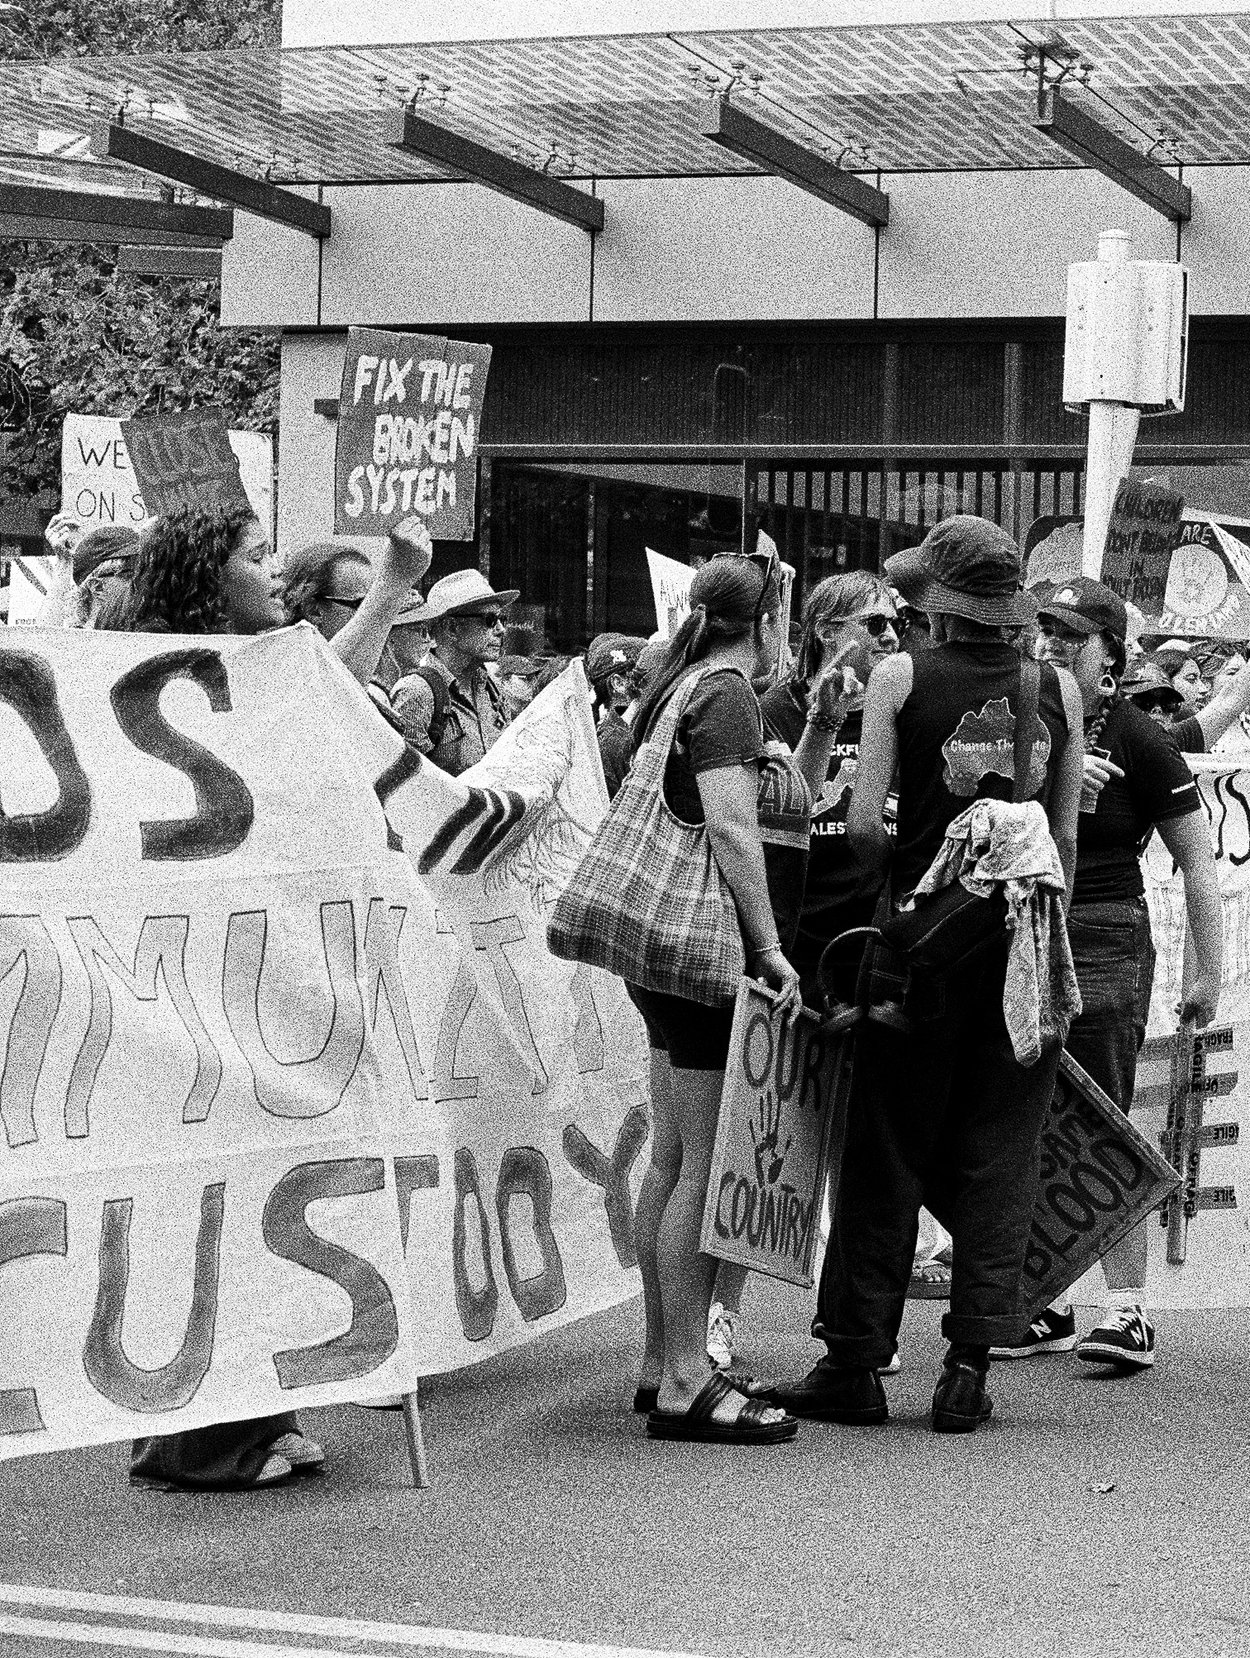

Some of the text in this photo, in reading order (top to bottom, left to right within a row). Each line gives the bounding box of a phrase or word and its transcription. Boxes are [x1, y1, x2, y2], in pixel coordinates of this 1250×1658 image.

[354, 354, 474, 409] FIX THE
[77, 437, 128, 470] WE
[373, 411, 475, 465] BROKEN
[76, 488, 116, 522] ON
[345, 464, 457, 518] SYSTEM
[1179, 524, 1212, 545] ARE
[950, 739, 993, 753] Change
[742, 1006, 823, 1113] OUR
[713, 1170, 813, 1275] COUNTRY
